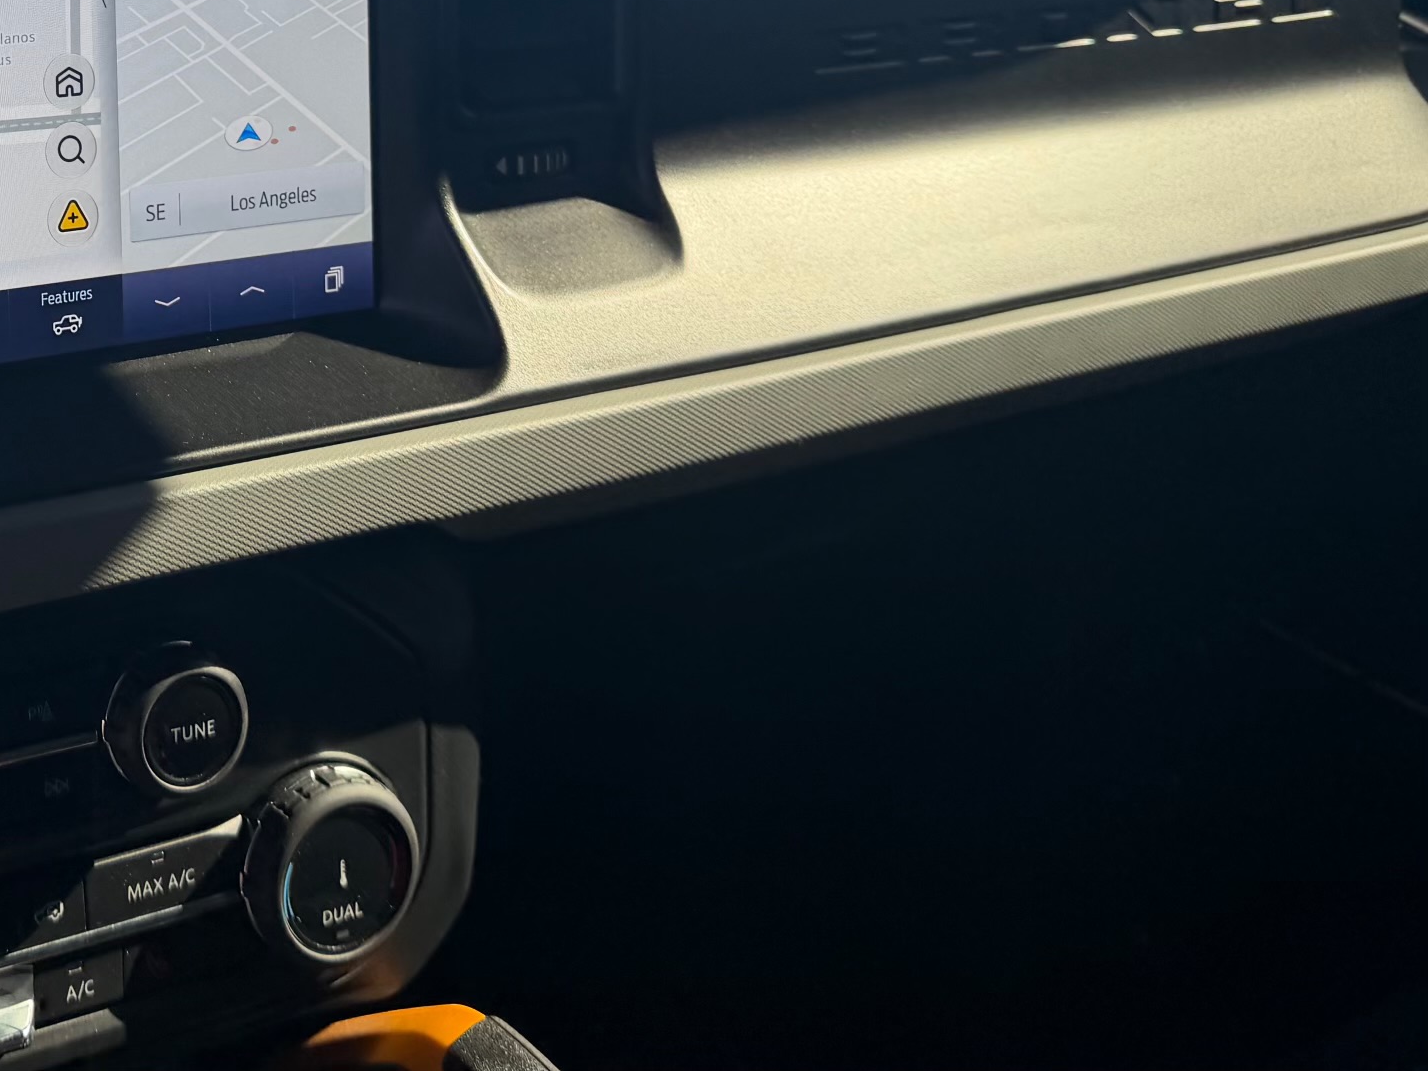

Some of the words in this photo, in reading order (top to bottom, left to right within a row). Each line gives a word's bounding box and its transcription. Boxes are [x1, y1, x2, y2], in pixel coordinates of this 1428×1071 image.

[230, 194, 256, 212] Los
[258, 186, 317, 209] Angeles
[145, 203, 166, 222] SE
[40, 288, 93, 306] Features
[170, 719, 216, 744] TUNE
[127, 877, 163, 904] MAX
[168, 867, 196, 891] A/C
[322, 901, 364, 927] DUAL
[66, 979, 95, 1003] A/C
